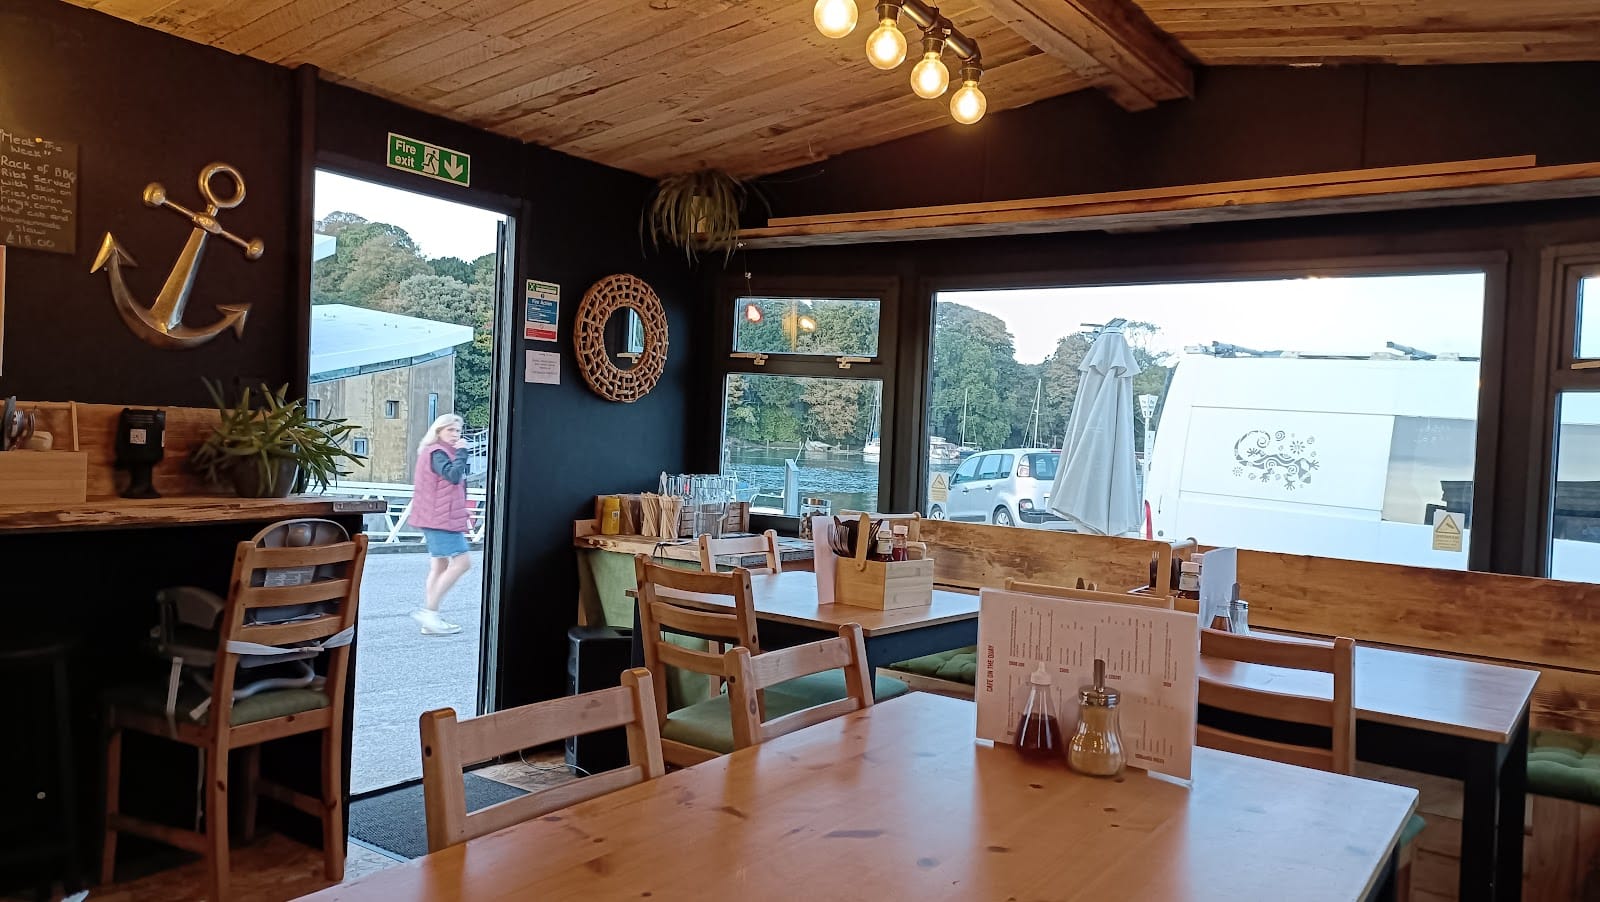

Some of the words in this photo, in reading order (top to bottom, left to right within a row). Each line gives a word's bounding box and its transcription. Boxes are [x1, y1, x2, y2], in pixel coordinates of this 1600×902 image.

[395, 139, 417, 155] Fire
[1, 155, 32, 170] Rack
[37, 164, 49, 174] of
[394, 154, 415, 168] exit
[1, 168, 27, 180] Ribs
[987, 645, 995, 659] QUAY
[987, 670, 994, 678] ON
[986, 679, 994, 692] CAFE
